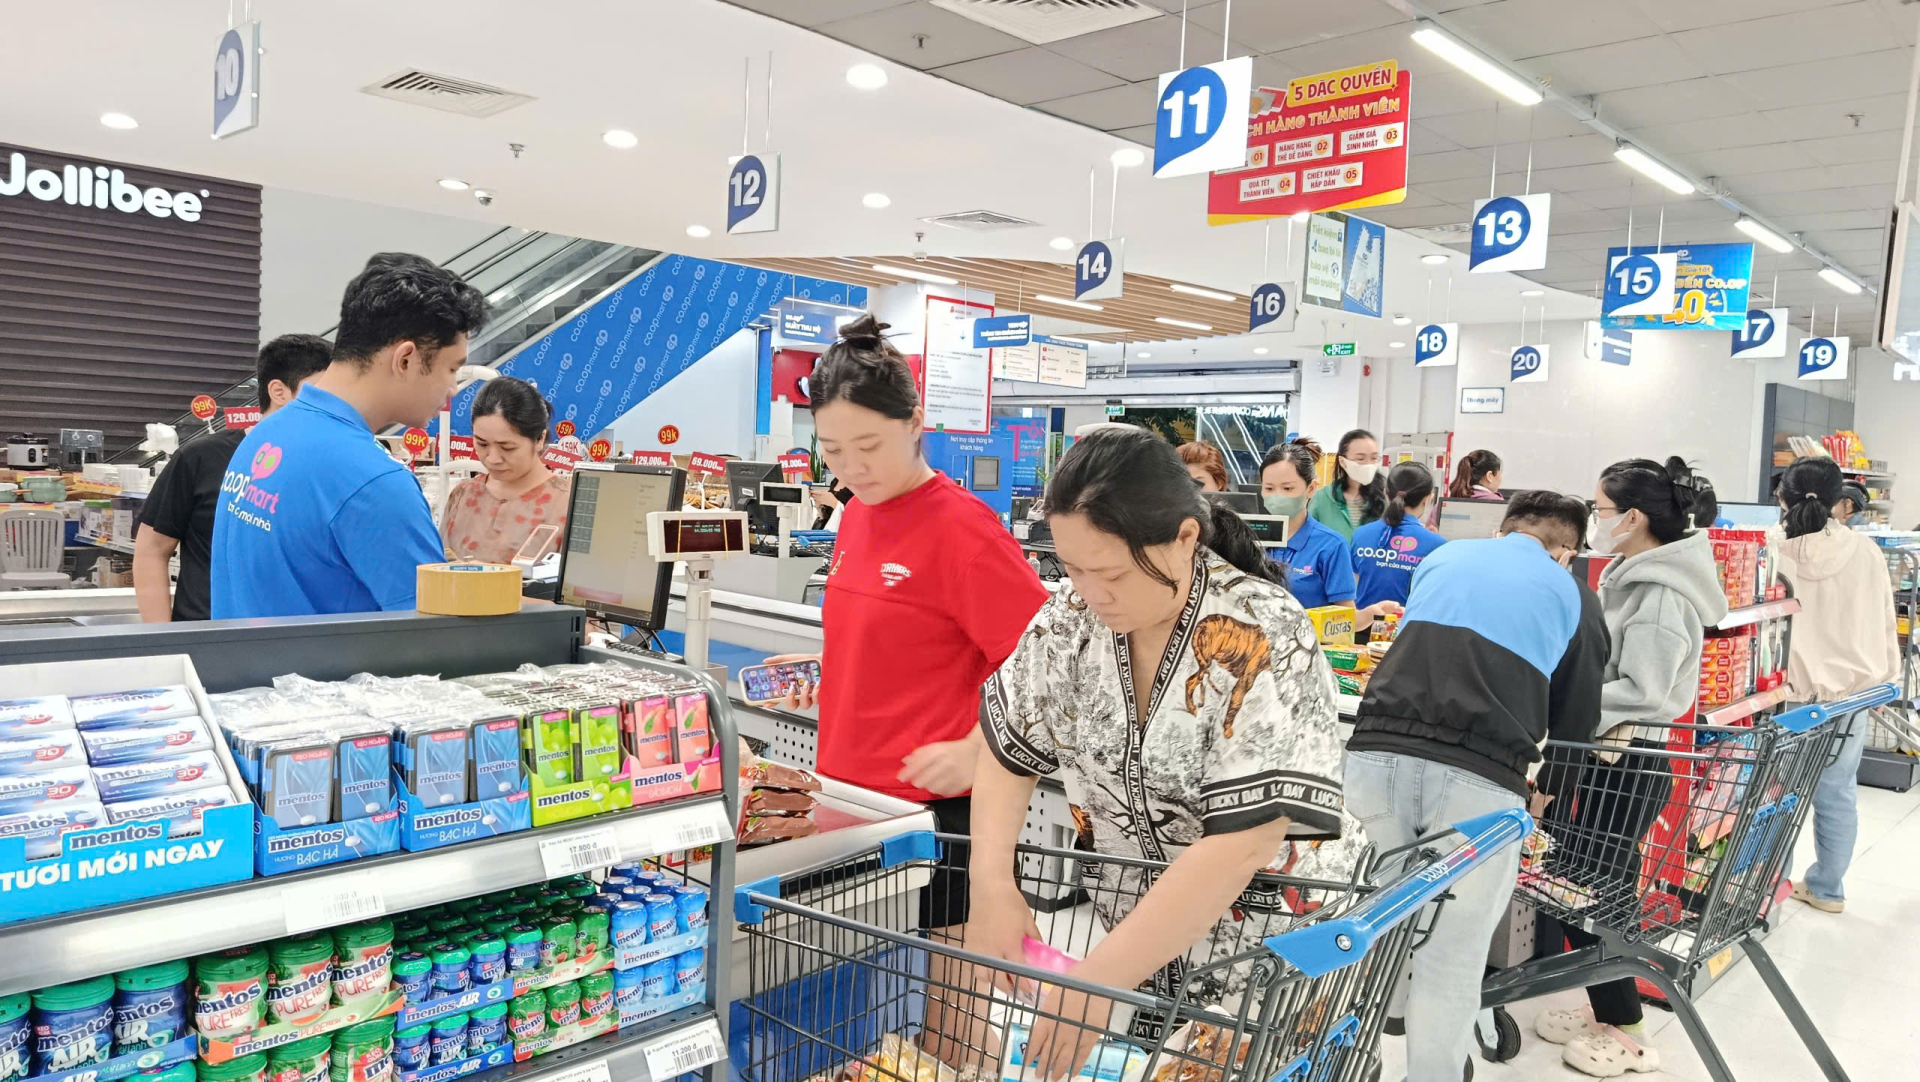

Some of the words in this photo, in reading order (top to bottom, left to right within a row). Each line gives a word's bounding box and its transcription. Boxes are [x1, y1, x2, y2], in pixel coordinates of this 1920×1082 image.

[214, 48, 239, 100] 10
[1295, 86, 1303, 101] 5
[1307, 78, 1335, 99] ĐẶC
[1340, 65, 1392, 92] QUYỀN
[1164, 86, 1210, 138] 11
[1265, 115, 1305, 134] HÀNG
[1308, 104, 1360, 127] THÀNH
[1363, 97, 1400, 116] VIÊN
[1386, 130, 1398, 140] 03
[1317, 142, 1328, 151] 02
[1347, 142, 1361, 151] SINH
[1362, 140, 1378, 149] NHẬT
[1253, 153, 1263, 161] 01
[1280, 179, 1290, 188] 04
[1346, 170, 1357, 179] 05
[0, 153, 202, 222] Jollibee
[730, 172, 761, 206] 12
[1478, 212, 1522, 247] 13
[1078, 254, 1106, 279] 14
[1615, 267, 1653, 295] 15
[1253, 292, 1280, 316] 16
[1740, 318, 1769, 341] 17
[1418, 333, 1443, 351] 18
[1513, 354, 1537, 371] 20
[1803, 347, 1833, 365] 19
[193, 400, 214, 412] 99K
[406, 432, 426, 448] 99K
[660, 430, 677, 443] 99k
[1187, 576, 1201, 611] LUCKY
[1181, 607, 1195, 628] DAY
[1324, 620, 1352, 637] Custas
[1120, 645, 1128, 663] DAY
[1168, 629, 1184, 662] LUCKY
[1121, 662, 1134, 697] LUCKY
[1160, 659, 1172, 681] DAY
[166, 733, 188, 742] 30
[640, 733, 668, 743] mentos
[681, 729, 706, 739] mentos
[990, 700, 1005, 729] LUCKY
[1000, 728, 1011, 747] DAY
[1010, 747, 1038, 767] LUCKY
[1037, 763, 1055, 773] DAY
[36, 748, 60, 756] 30
[538, 751, 570, 762] mentos
[584, 745, 616, 756] mentos
[177, 768, 198, 777] 30
[480, 761, 517, 773] mentos
[1130, 759, 1139, 779] DAY
[344, 781, 387, 793] mentos
[420, 772, 462, 784] mentos
[634, 770, 682, 787] mentos
[48, 785, 72, 794] 30
[538, 789, 590, 807] mentos
[1209, 792, 1241, 810] LUCKY
[1242, 786, 1265, 804] DAY
[1283, 783, 1307, 798] DAY
[278, 793, 325, 806] mentos
[113, 799, 198, 820] mentos
[416, 809, 481, 829] mentos
[440, 829, 459, 842] BẠC
[463, 822, 477, 837] HÀ
[1136, 812, 1145, 833] DAY
[71, 824, 162, 849] mentos
[270, 830, 343, 851] mentos
[1142, 831, 1157, 860] LUCKY
[297, 851, 320, 865] BẠC
[323, 844, 339, 860] HÀ
[570, 844, 591, 854] 17.800
[0, 861, 70, 892] TƯƠI
[78, 850, 137, 879] MỚI
[144, 839, 224, 867] NGAY
[331, 947, 393, 982] mentos
[512, 958, 524, 966] AIR
[624, 950, 660, 965] mentos
[268, 964, 333, 1000] mentos
[337, 978, 373, 998] PURE
[516, 974, 550, 988] mentos
[116, 995, 174, 1024] entos
[275, 995, 313, 1017] PURE
[406, 1001, 457, 1023] mentos
[457, 992, 480, 1008] AIR
[621, 1007, 657, 1023] mentos
[38, 1007, 114, 1052] mentos
[234, 1031, 299, 1057] mentos
[300, 1023, 325, 1038] PURE
[520, 1037, 553, 1053] mentos
[48, 1036, 96, 1072] AIR
[439, 1045, 462, 1063] AIR
[672, 1045, 692, 1057] 11.200
[457, 1058, 482, 1074] AIR
